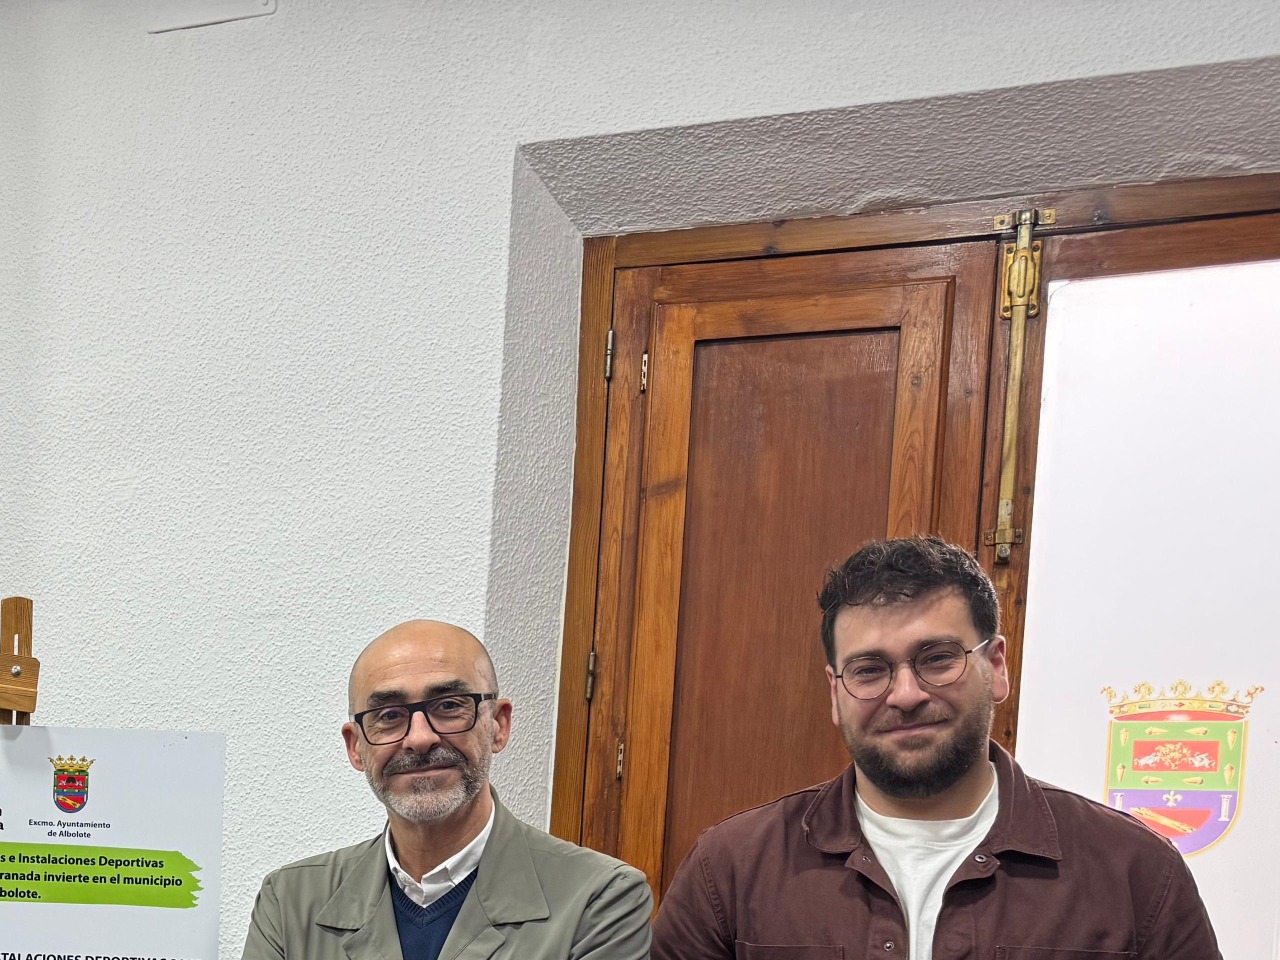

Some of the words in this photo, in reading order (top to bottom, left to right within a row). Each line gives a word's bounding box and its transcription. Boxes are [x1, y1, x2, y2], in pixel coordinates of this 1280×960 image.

[29, 819, 55, 827] Excmo.
[56, 820, 111, 829] Ayuntamiento
[58, 830, 91, 838] Albolote
[9, 855, 15, 863] e
[19, 853, 96, 866] Instalaciones
[99, 856, 164, 869] Deportivas
[44, 871, 89, 883] invierte
[110, 873, 120, 884] el
[123, 875, 182, 888] municipio
